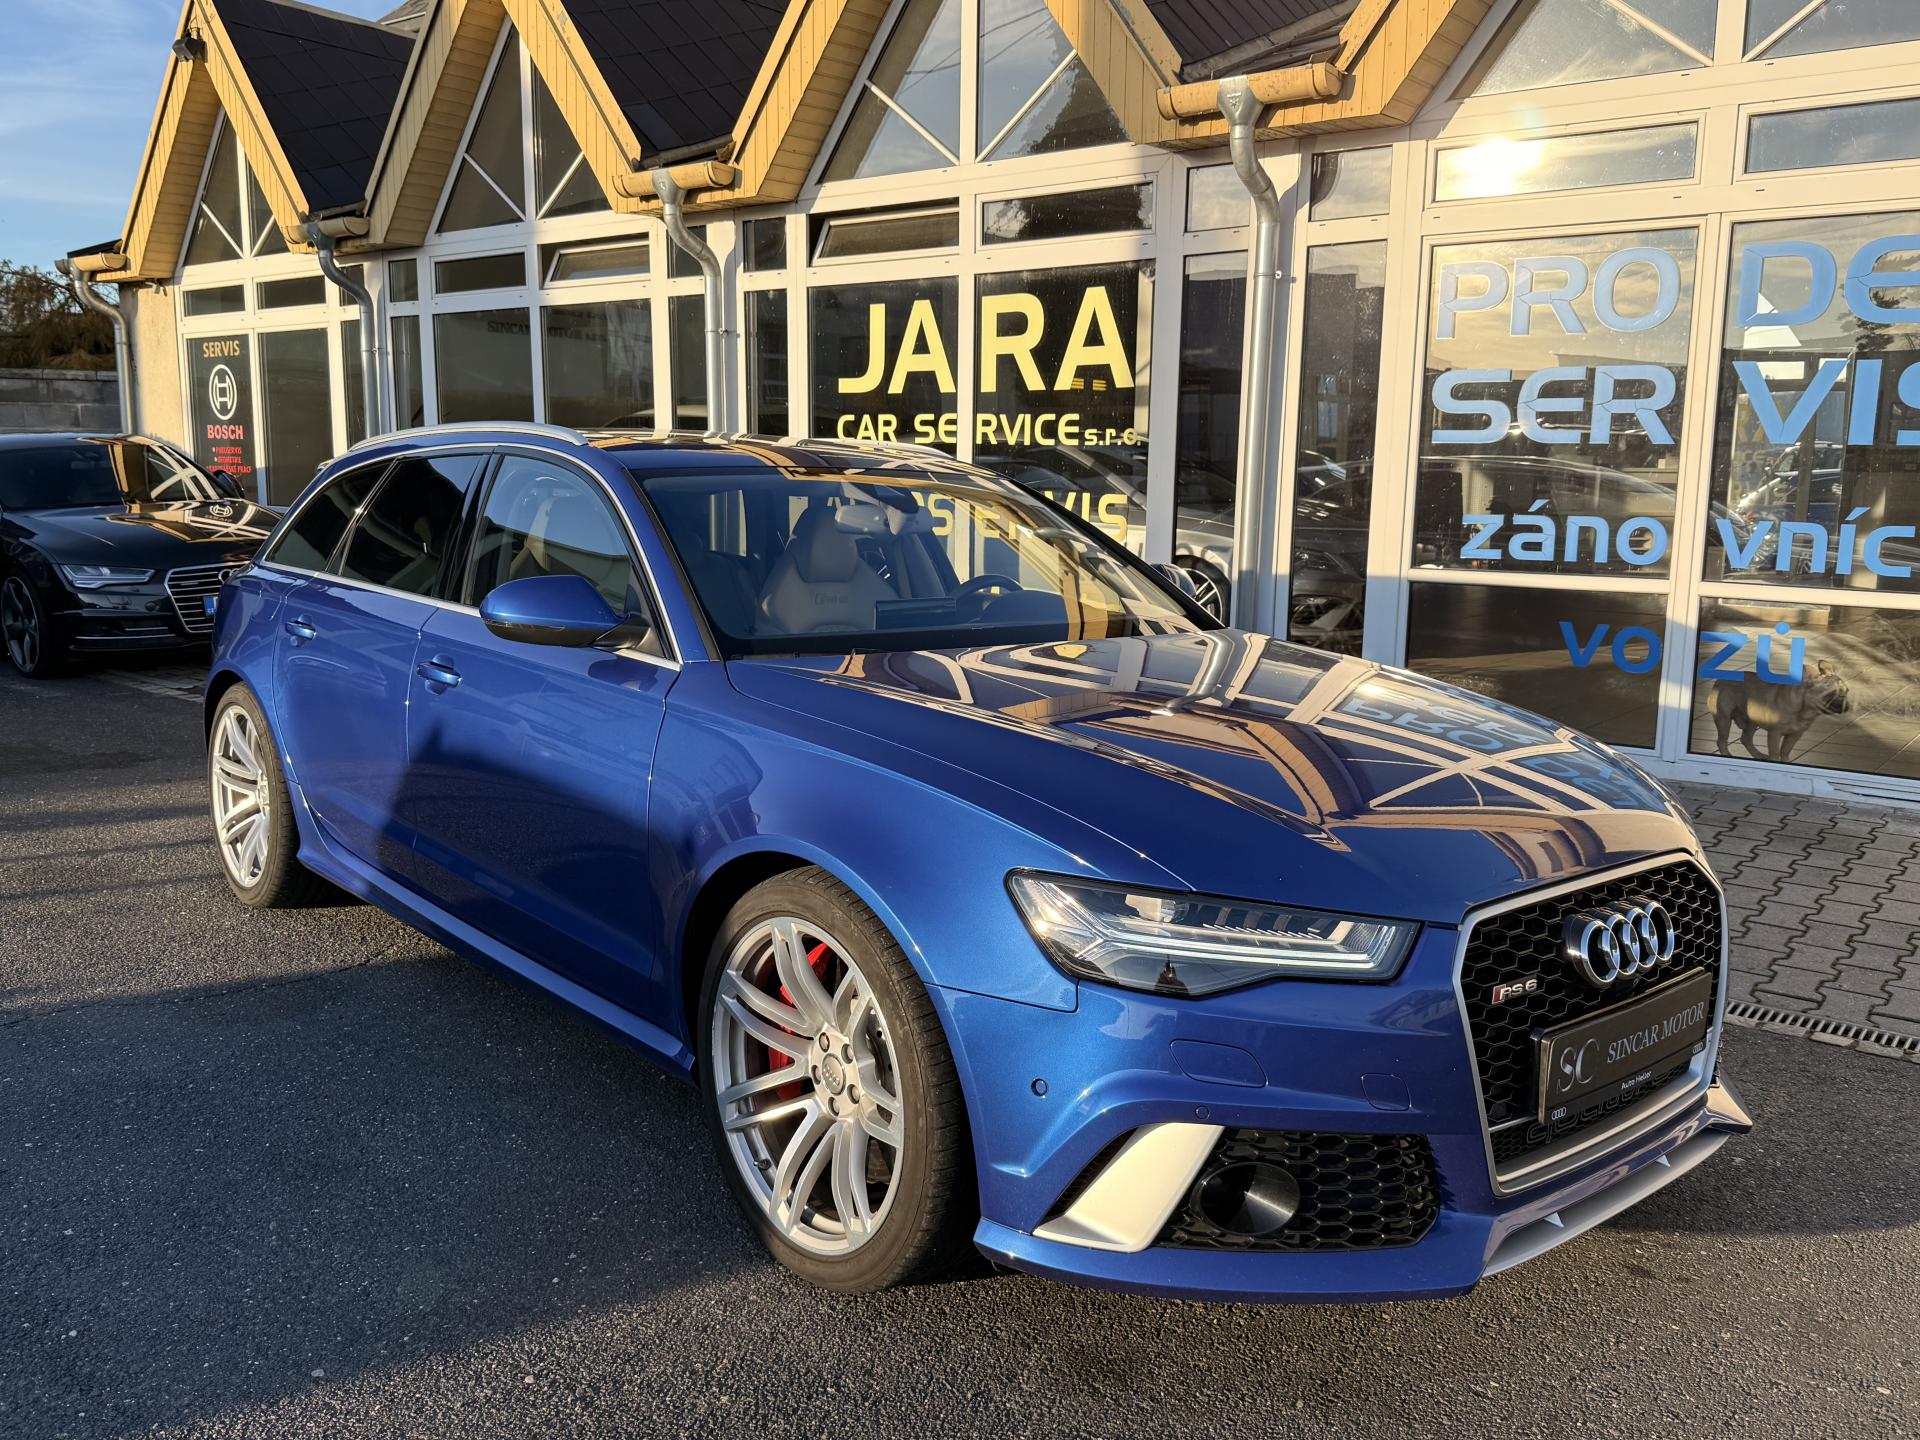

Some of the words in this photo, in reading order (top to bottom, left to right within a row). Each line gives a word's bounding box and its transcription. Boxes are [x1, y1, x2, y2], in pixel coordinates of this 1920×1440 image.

[203, 341, 240, 358] SERVIS
[207, 425, 243, 440] BOSCH
[837, 413, 898, 443] CAR
[1606, 1024, 1659, 1064] SINCAR
[1660, 1001, 1705, 1041] MOTOR
